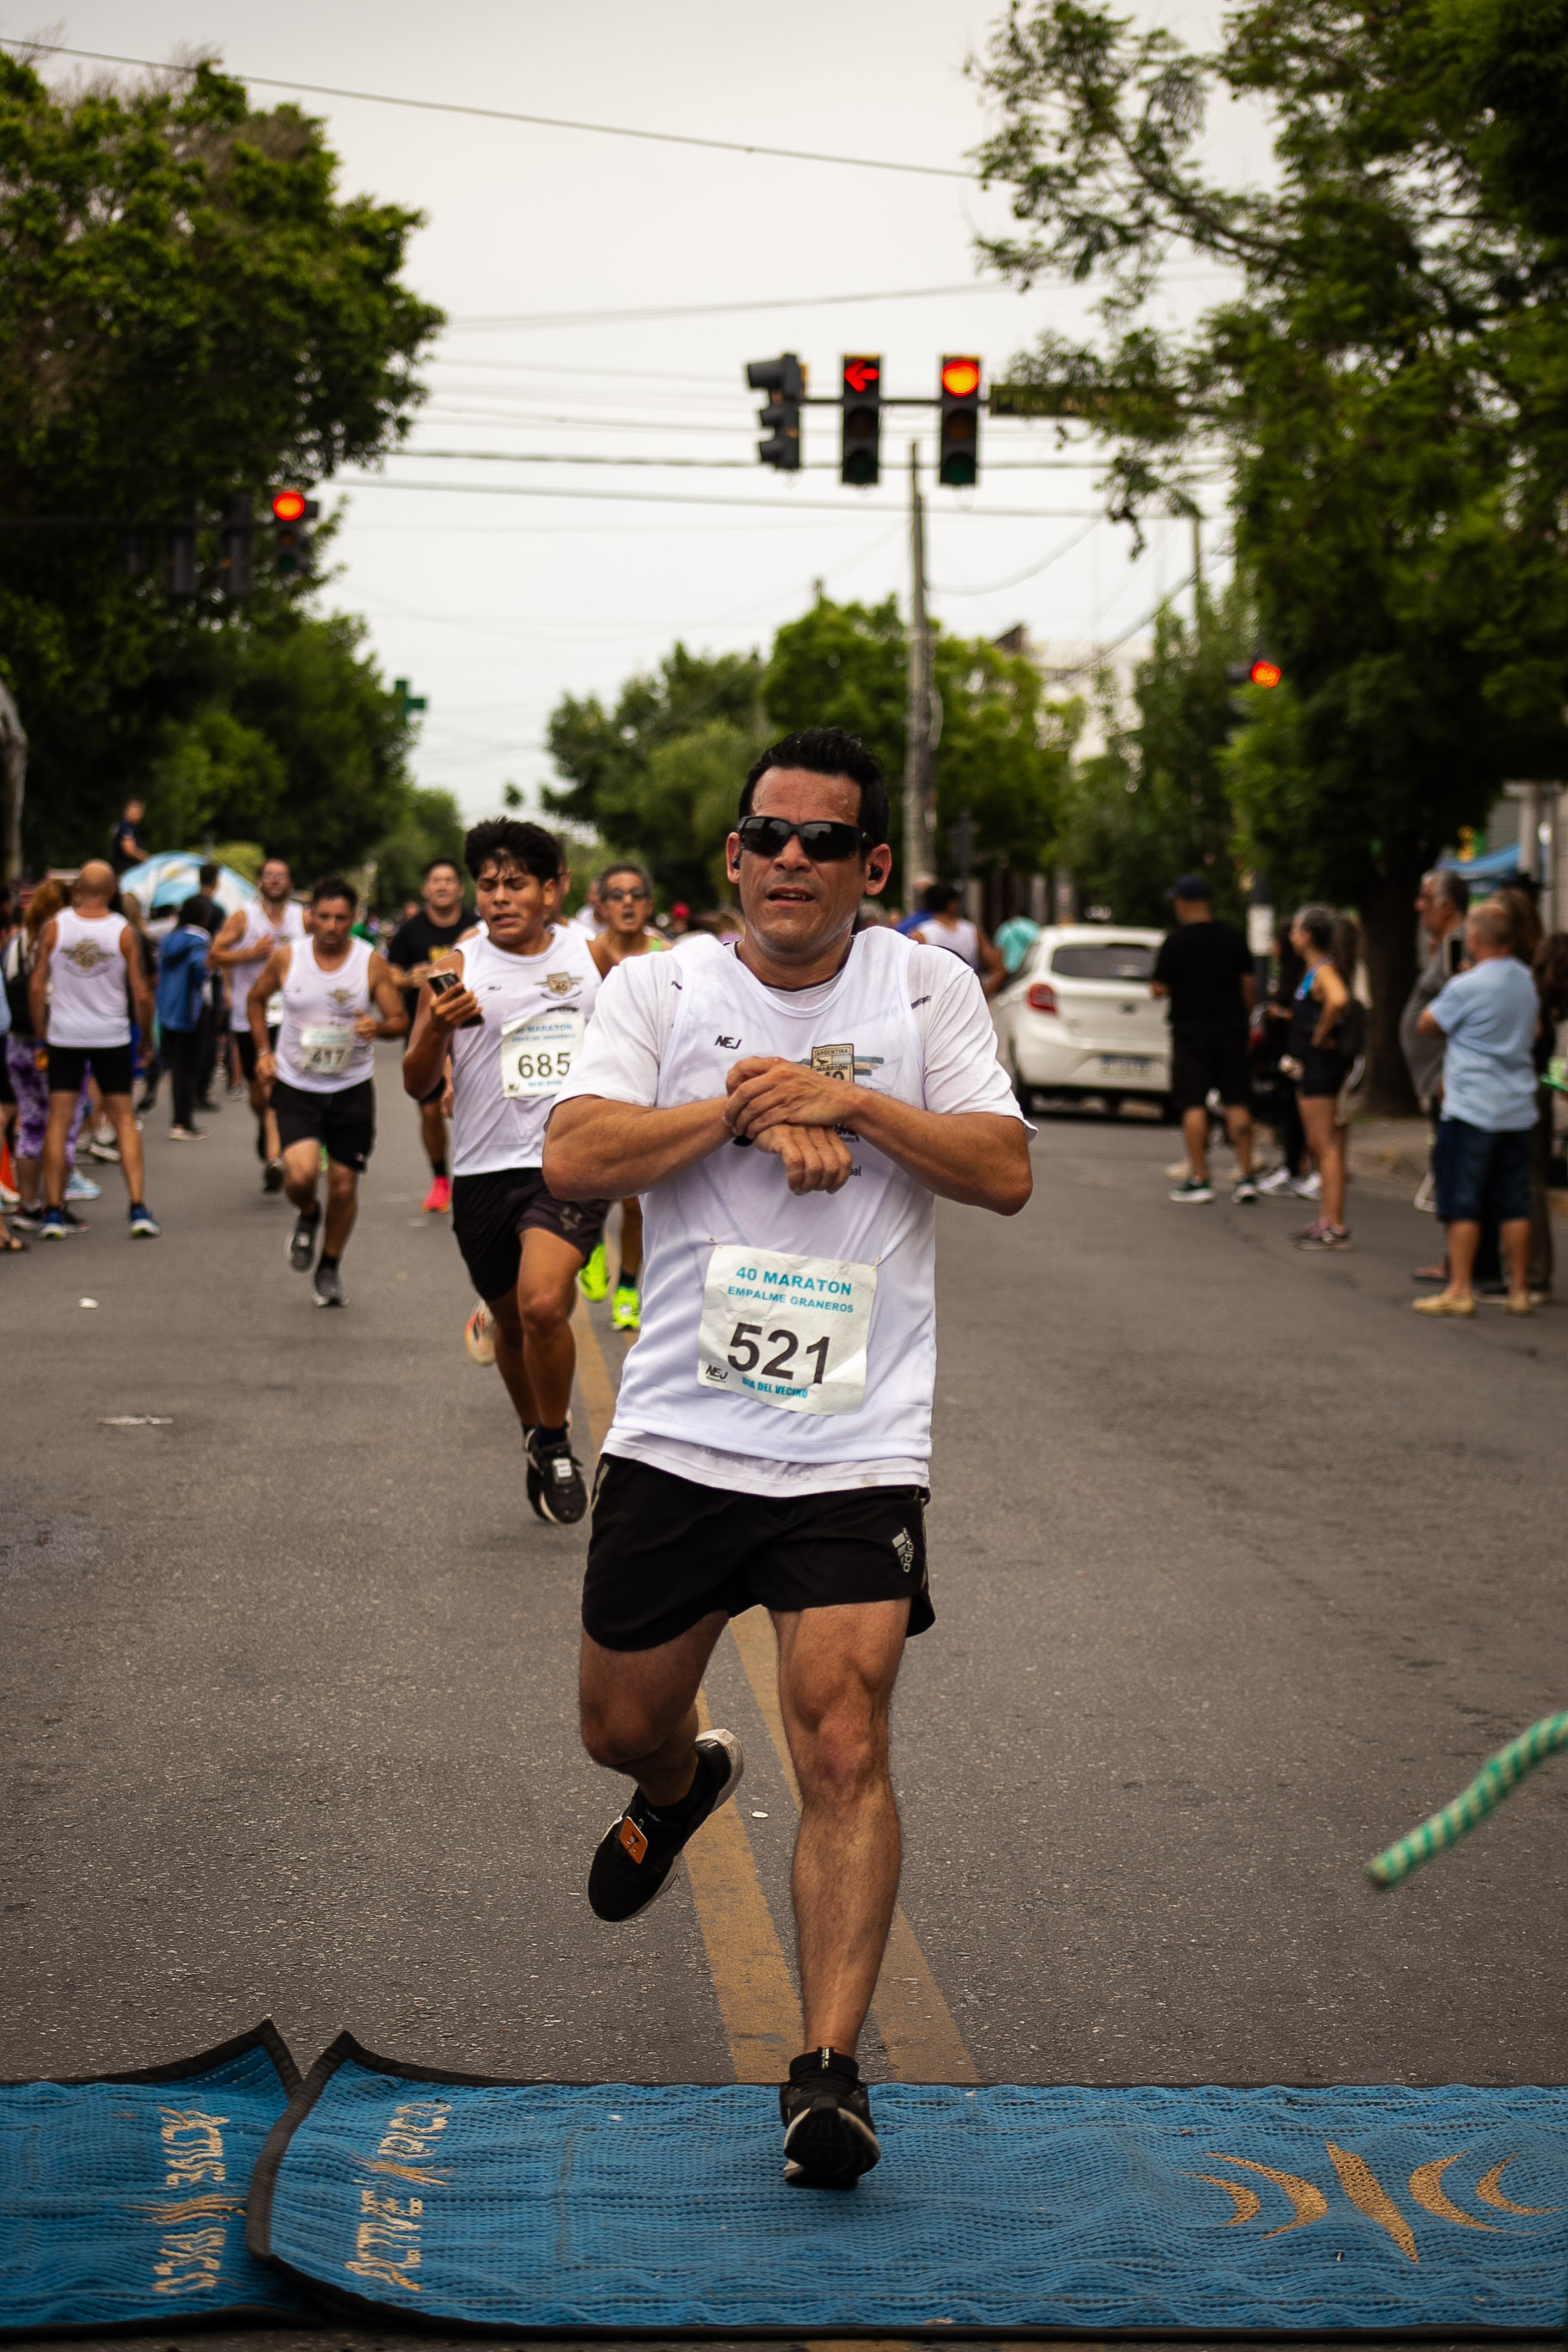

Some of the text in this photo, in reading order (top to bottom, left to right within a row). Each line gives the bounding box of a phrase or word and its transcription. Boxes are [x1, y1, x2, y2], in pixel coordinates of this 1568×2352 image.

[714, 1035, 742, 1050] NEJ
[816, 1048, 848, 1057] ARGENTINA
[518, 1051, 571, 1079] 685
[736, 1266, 852, 1295] 40 MARATON
[727, 1285, 854, 1314] EMPALME GRANEROS
[727, 1321, 830, 1385] 521
[705, 1364, 729, 1380] NEJ
[742, 1376, 756, 1390] DIA
[757, 1382, 773, 1393] DEL
[775, 1385, 808, 1399] VECINO
